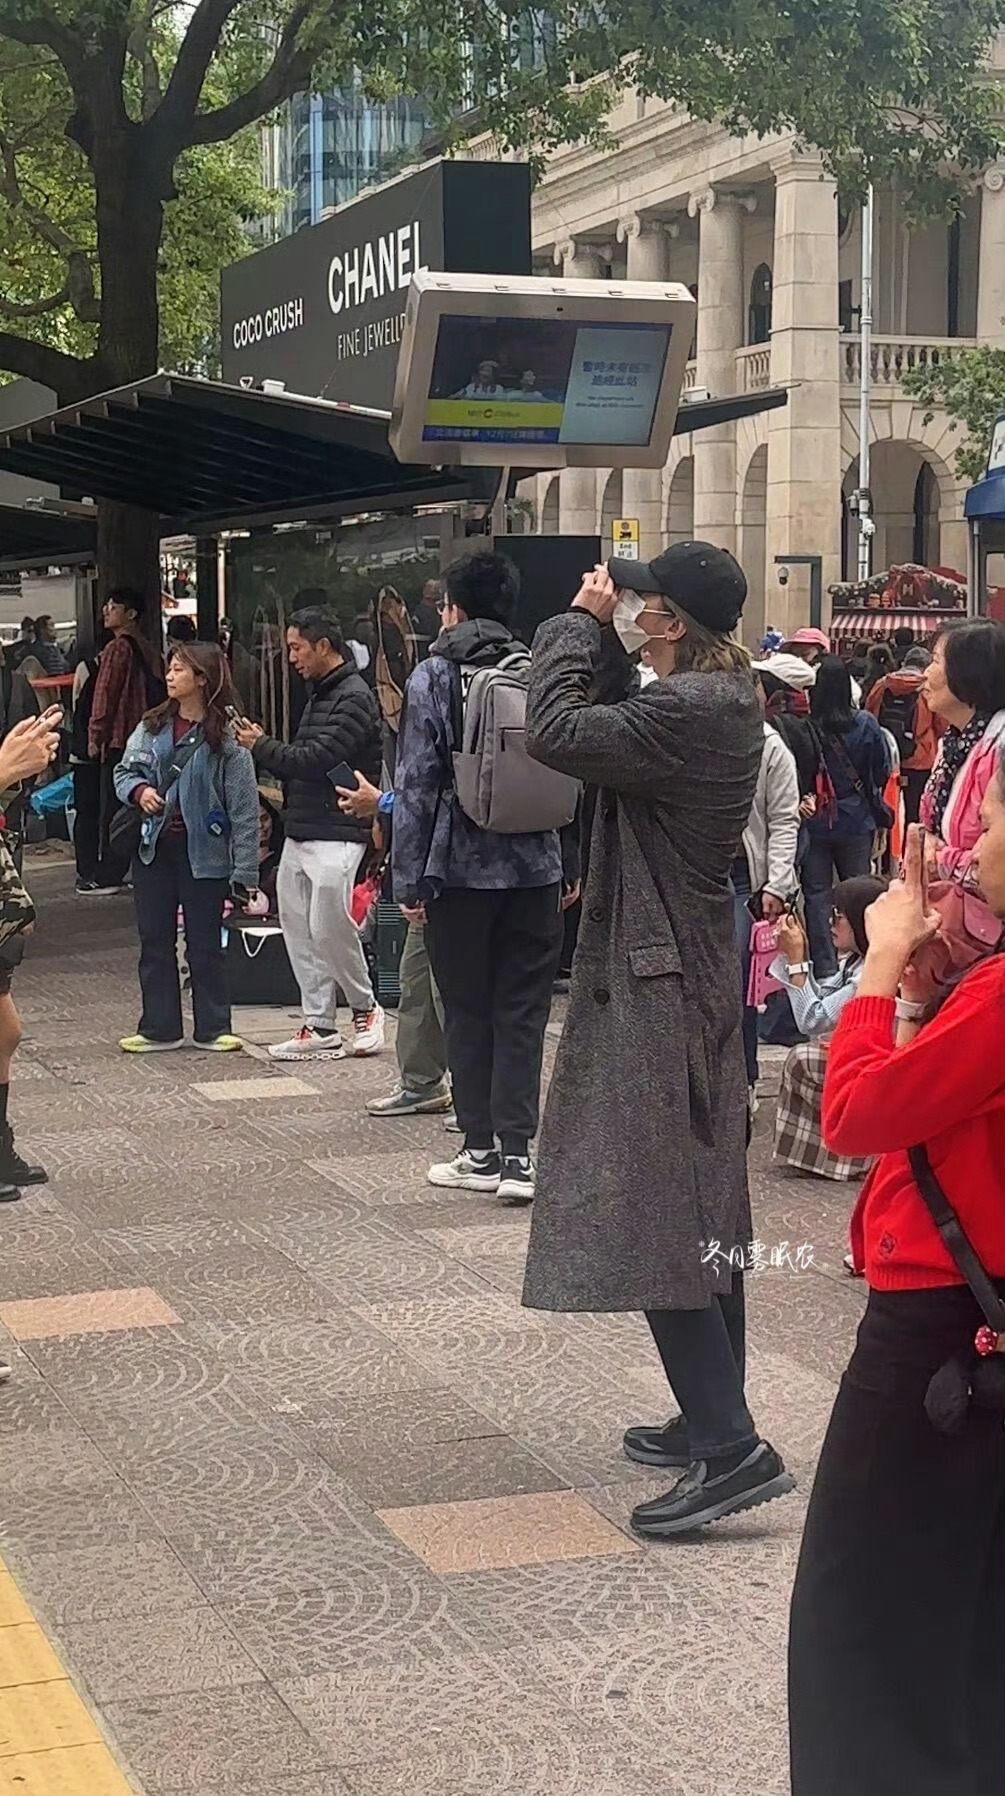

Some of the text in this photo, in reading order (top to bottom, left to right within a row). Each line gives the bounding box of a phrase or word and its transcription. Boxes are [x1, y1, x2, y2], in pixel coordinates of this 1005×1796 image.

[328, 220, 428, 315] CHANEL
[233, 297, 304, 349] COCO CRUSH
[337, 328, 360, 360] FINE
